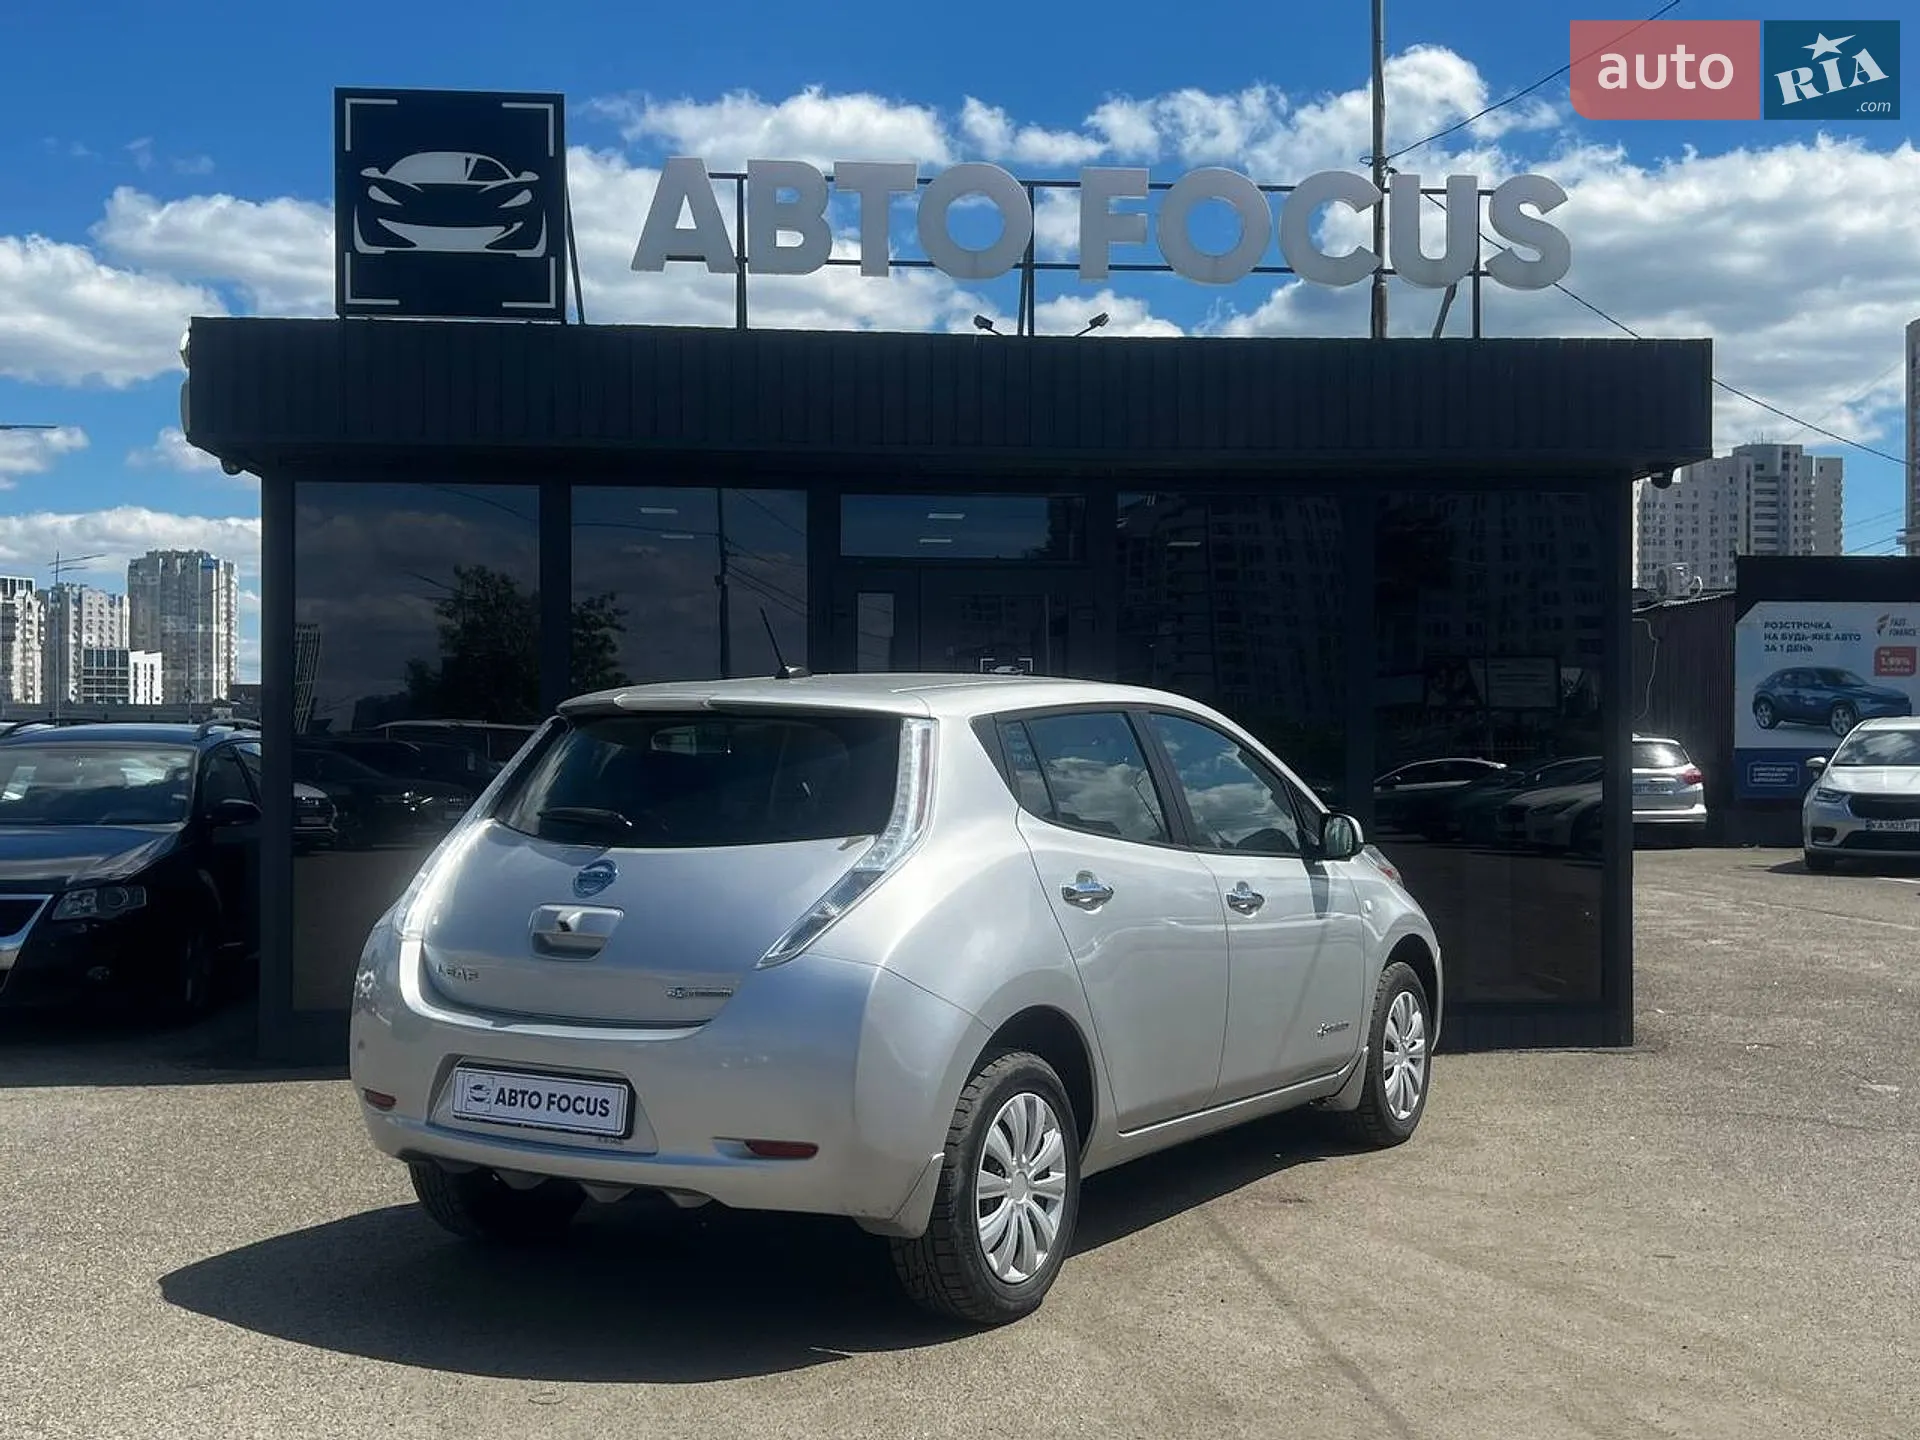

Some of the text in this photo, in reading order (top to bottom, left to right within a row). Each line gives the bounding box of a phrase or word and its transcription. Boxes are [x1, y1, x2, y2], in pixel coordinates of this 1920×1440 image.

[631, 156, 1572, 290] АВТО FOCUS
[1764, 632, 1778, 641] НА
[1834, 633, 1862, 641] АВТО
[1764, 644, 1777, 652] ЗА
[1786, 644, 1814, 653] ДЕНЬ
[494, 1087, 610, 1118] АВТО FOCUS
